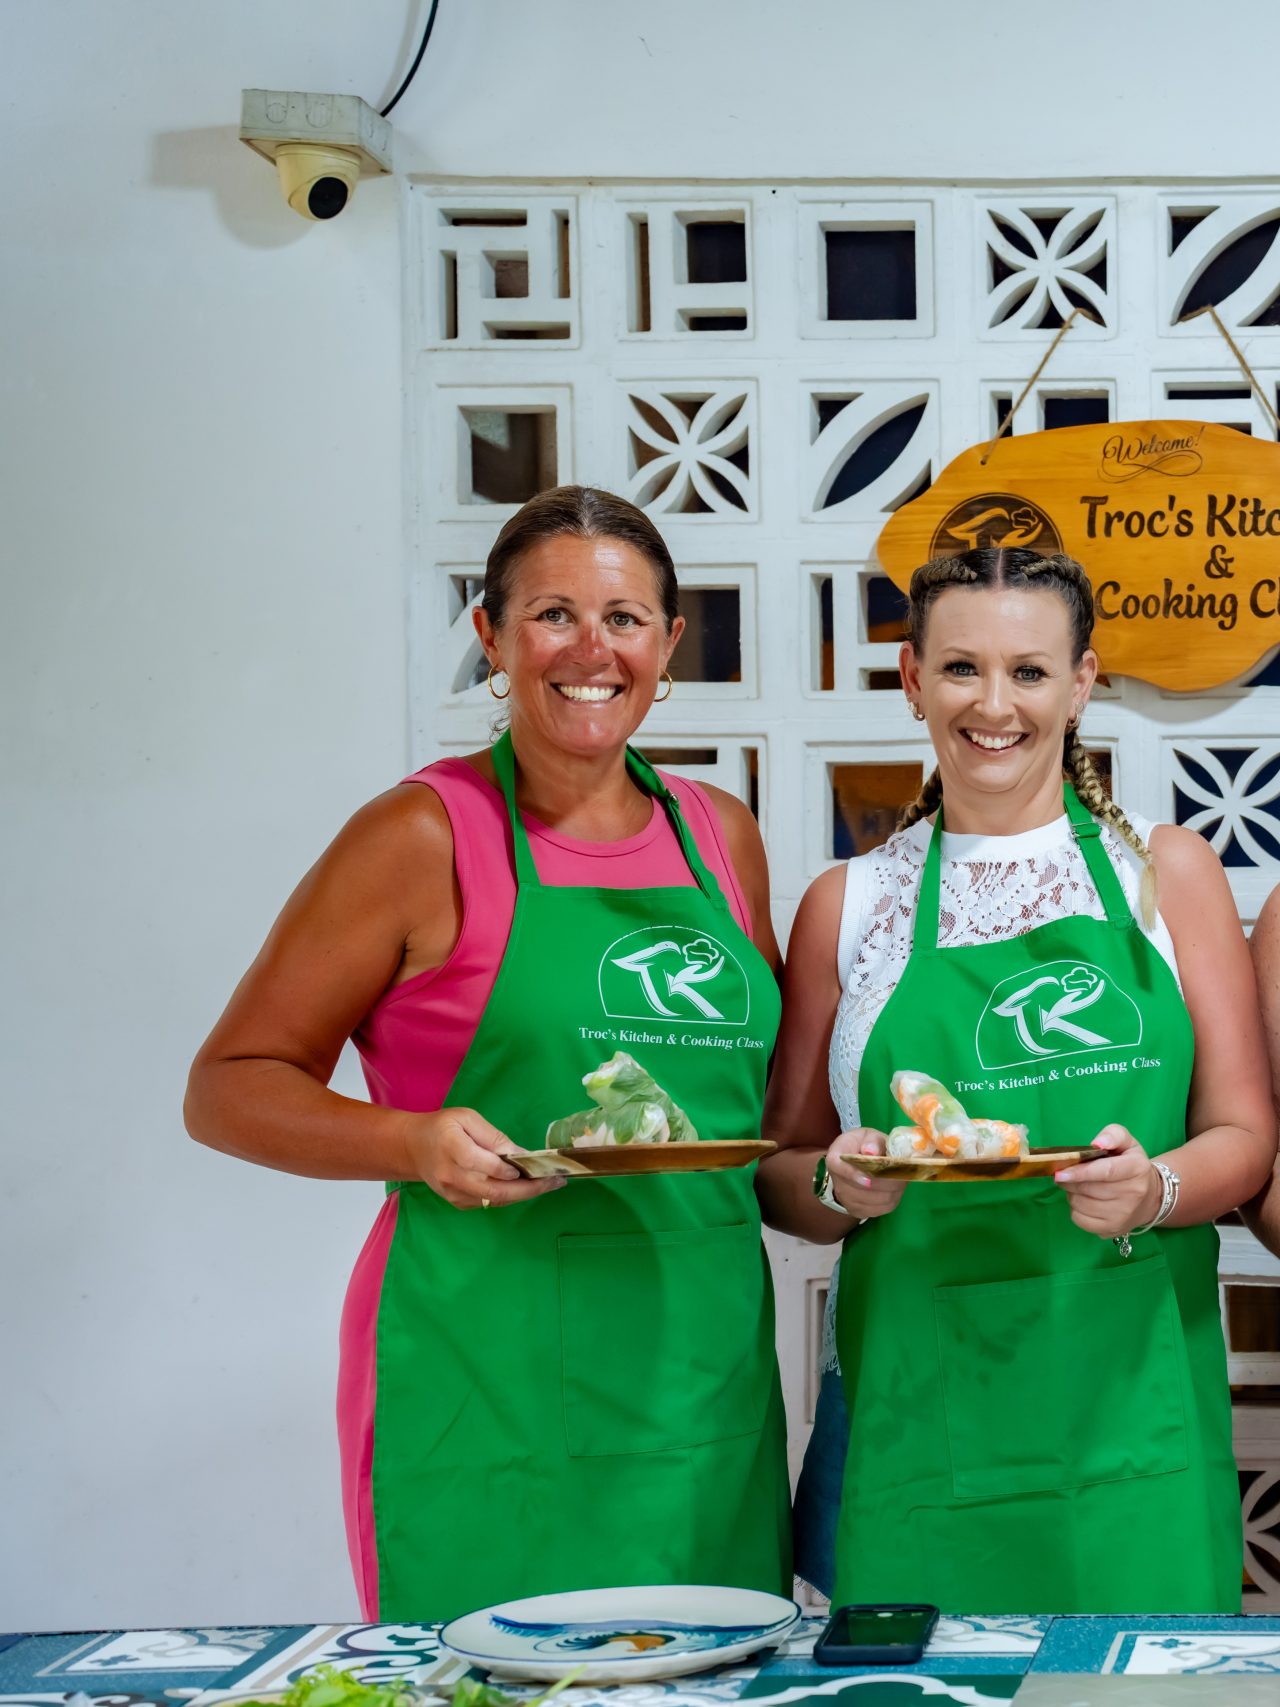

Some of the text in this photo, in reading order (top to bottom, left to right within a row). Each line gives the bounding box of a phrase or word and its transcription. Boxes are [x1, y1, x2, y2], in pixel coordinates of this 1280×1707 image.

[1101, 425, 1206, 465] Welcome!
[1080, 494, 1194, 539] Troc's
[1204, 544, 1235, 580] &
[1095, 577, 1238, 631] Cooking
[579, 1027, 764, 1050] Troc's Kitchen & Cooking Class
[954, 1056, 1161, 1093] Troc's Kitchen & Cooking Class
